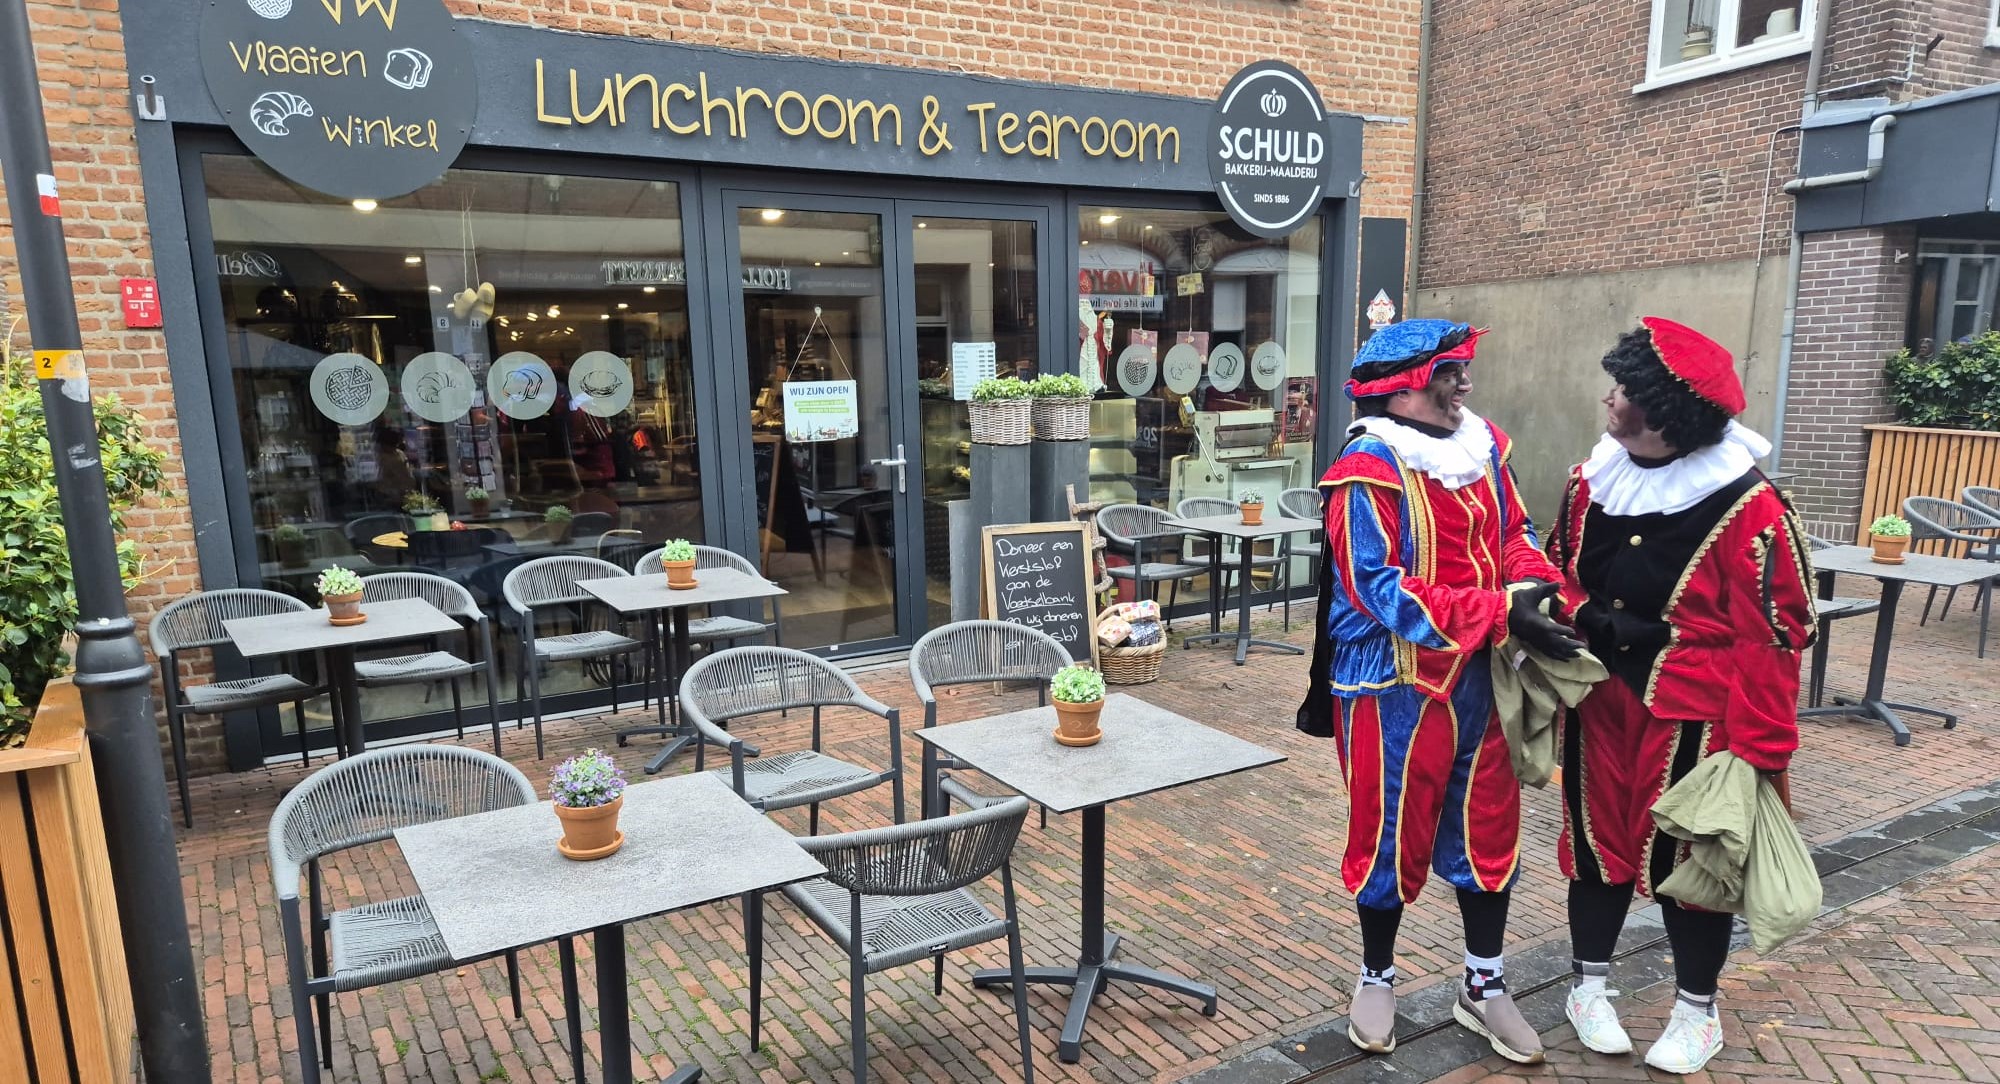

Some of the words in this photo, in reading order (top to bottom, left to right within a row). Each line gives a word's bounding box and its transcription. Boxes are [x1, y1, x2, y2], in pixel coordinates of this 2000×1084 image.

[229, 40, 367, 78] Vlaaien
[535, 57, 902, 147] Lunchroom
[918, 94, 953, 157] &
[966, 102, 1181, 164] Tearoom
[321, 115, 439, 152] Winkel
[1218, 125, 1324, 165] SCHULD
[1224, 162, 1318, 179] BAKKERIJ-MAALDERIJ
[1253, 193, 1274, 204] SINDS
[1274, 194, 1290, 204] 1886
[42, 357, 52, 368] 2
[789, 387, 805, 396] WIJ
[806, 386, 825, 396] ZIJN
[826, 385, 849, 395] OPEN
[996, 538, 1046, 557] Doneer
[1052, 541, 1074, 551] een
[1005, 581, 1031, 591] aan
[1035, 574, 1053, 588] de
[1001, 590, 1076, 611] Voedselbank
[1043, 610, 1083, 623] doneren
